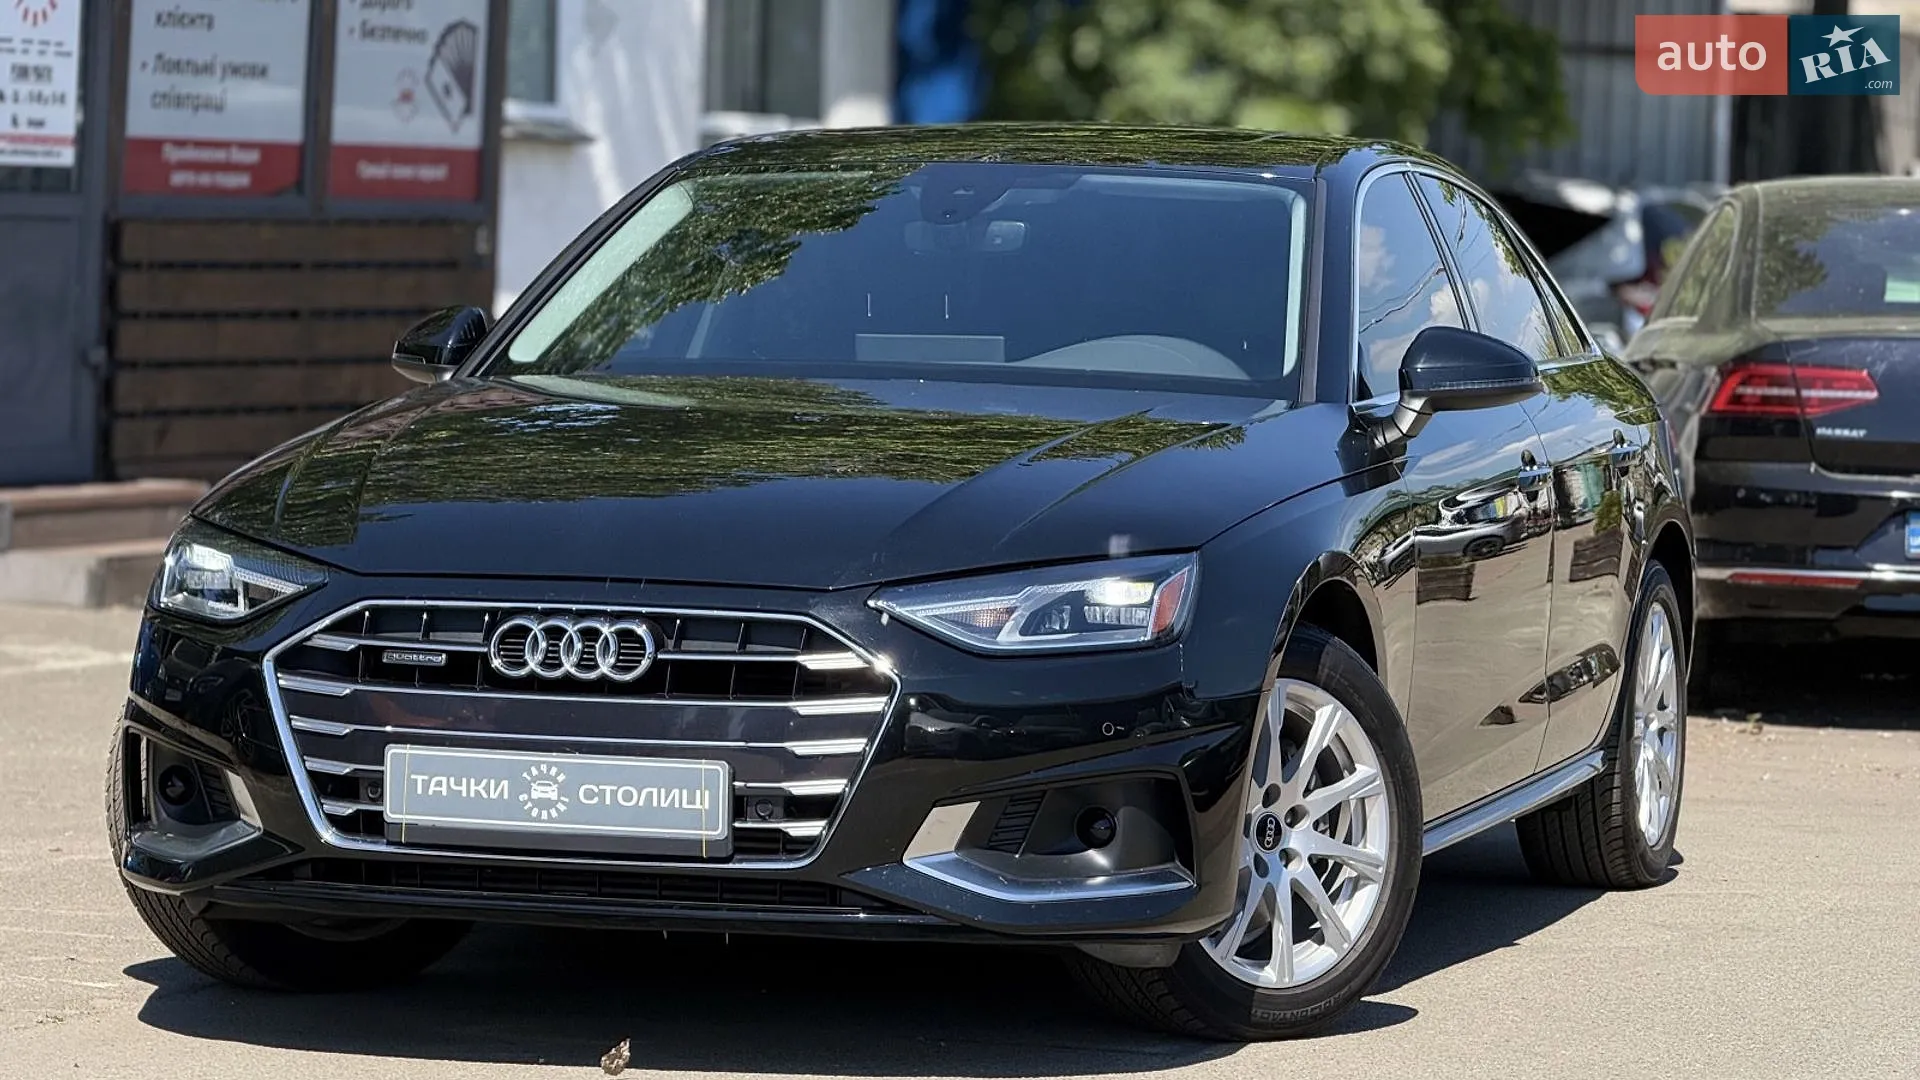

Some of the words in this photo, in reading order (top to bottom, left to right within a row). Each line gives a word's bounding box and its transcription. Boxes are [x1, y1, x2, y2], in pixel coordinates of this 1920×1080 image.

[386, 652, 442, 663] quattro
[410, 774, 509, 800] ТАЧКИ
[578, 784, 710, 810] СТОЛИЦІ
